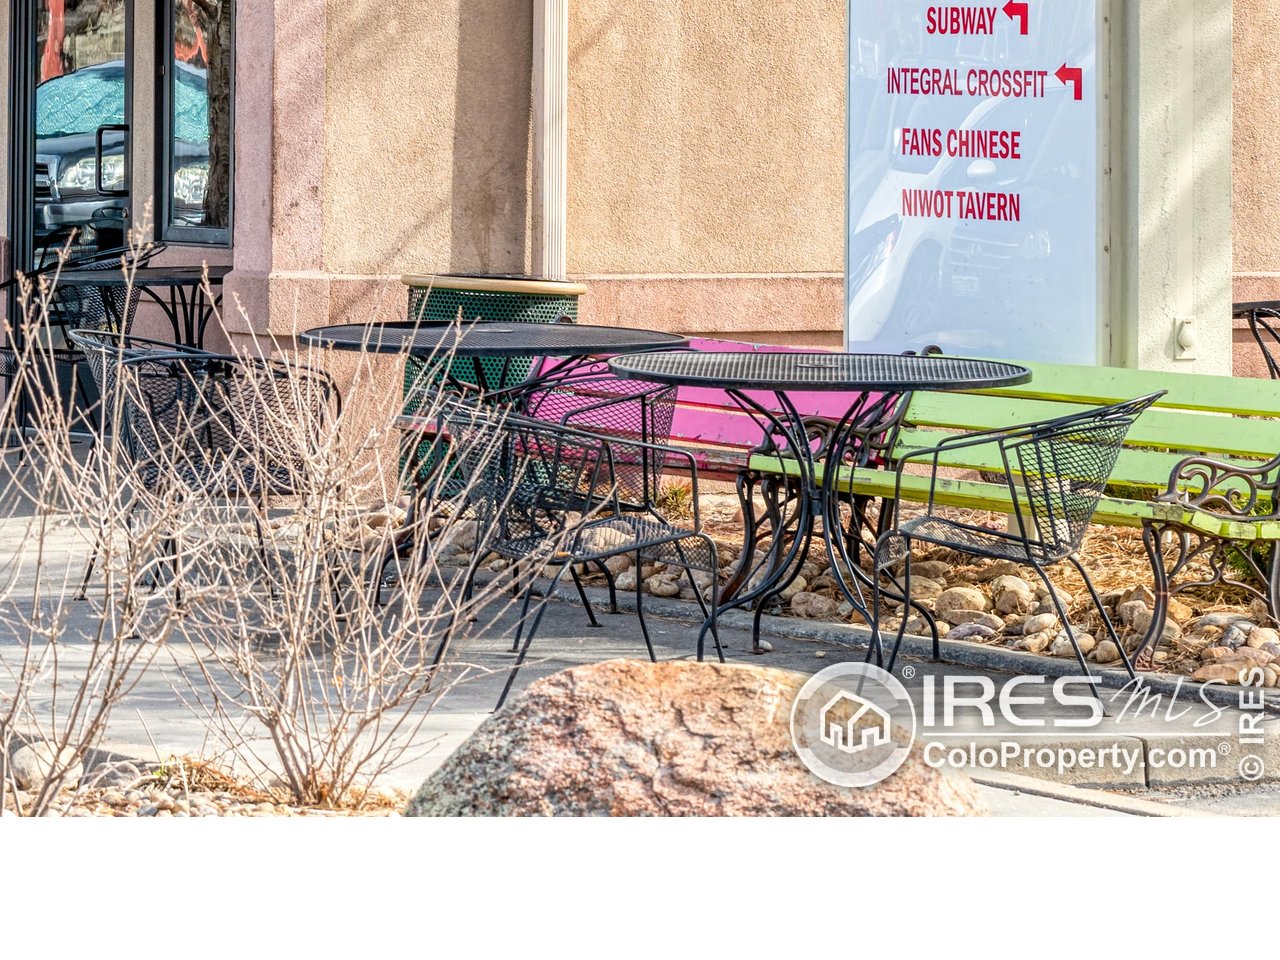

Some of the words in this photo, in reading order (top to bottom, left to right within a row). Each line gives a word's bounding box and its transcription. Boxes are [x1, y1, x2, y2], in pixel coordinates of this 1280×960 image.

[926, 6, 997, 35] SUBWAY
[887, 68, 963, 97] INTEGRAL
[966, 69, 1048, 98] CROSSFIT
[901, 128, 942, 157] FANS
[946, 129, 1021, 160] CHINESE
[902, 189, 954, 219] NIWOT
[956, 190, 1021, 221] TAVERN
